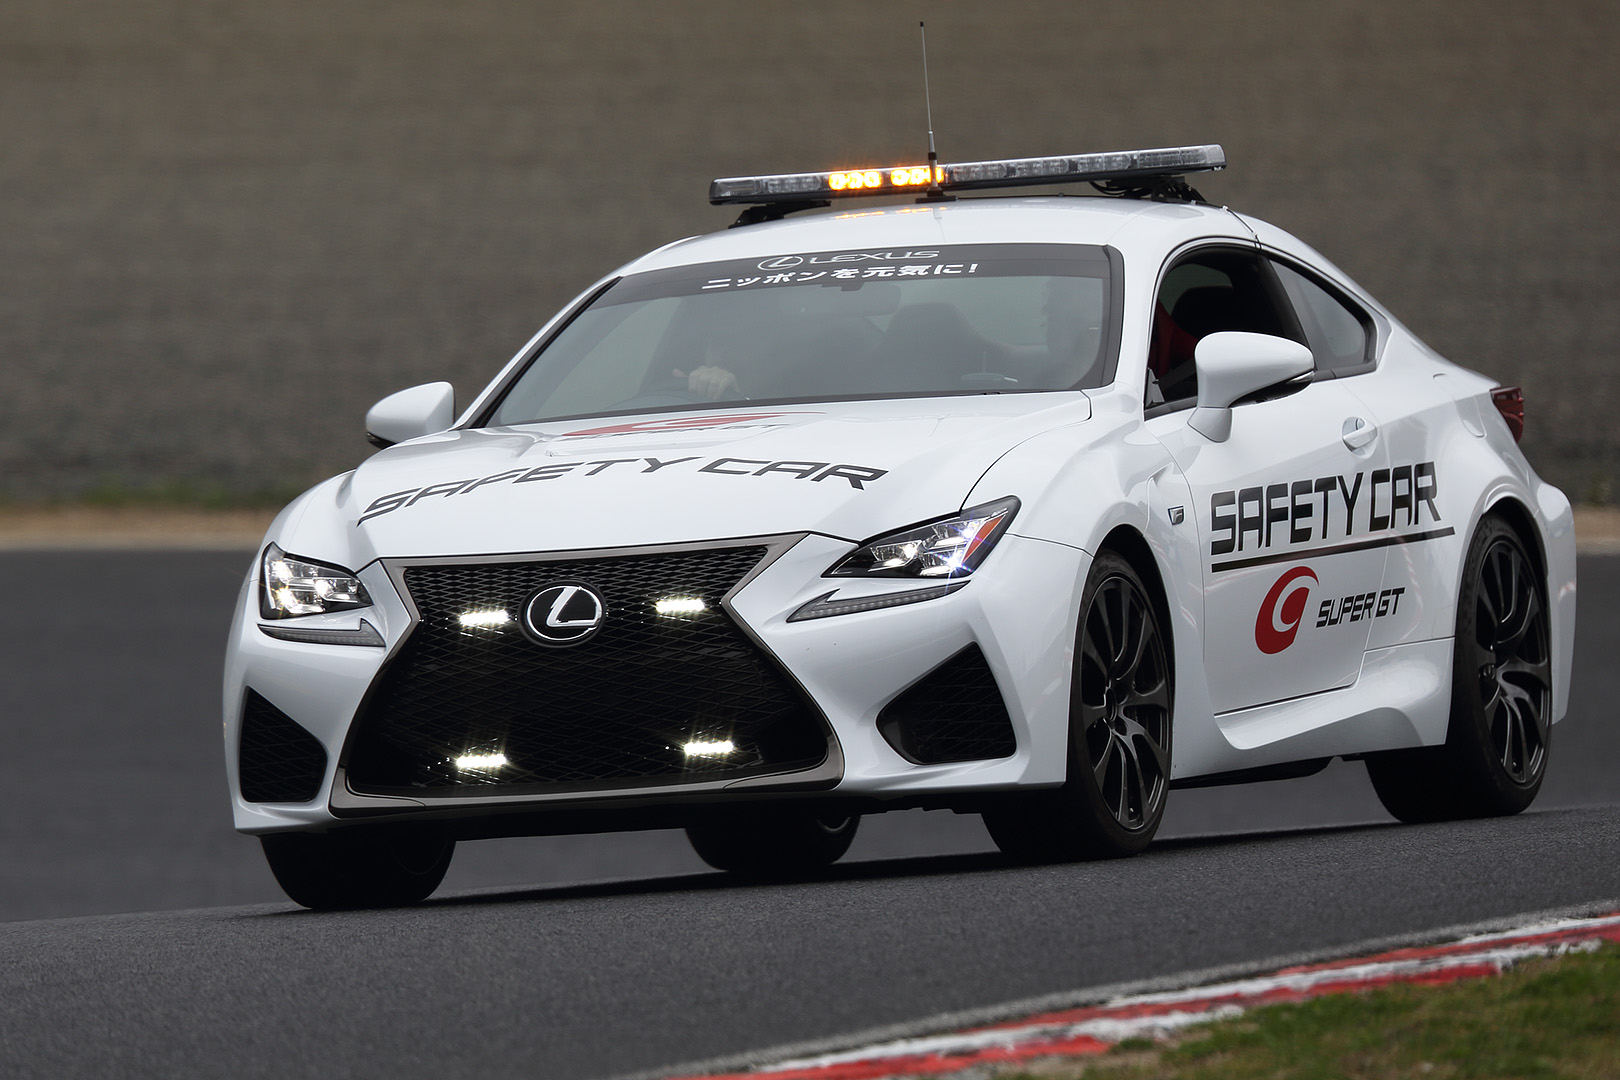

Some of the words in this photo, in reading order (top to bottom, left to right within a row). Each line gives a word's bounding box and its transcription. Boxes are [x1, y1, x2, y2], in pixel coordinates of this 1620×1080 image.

[809, 250, 940, 264] LEXUS
[356, 456, 704, 527] SAFETY
[697, 457, 889, 491] CAR
[1211, 472, 1364, 556] SAFETY
[1369, 461, 1441, 532] CAR
[1315, 592, 1376, 628] SUPER
[1375, 587, 1406, 618] GT
